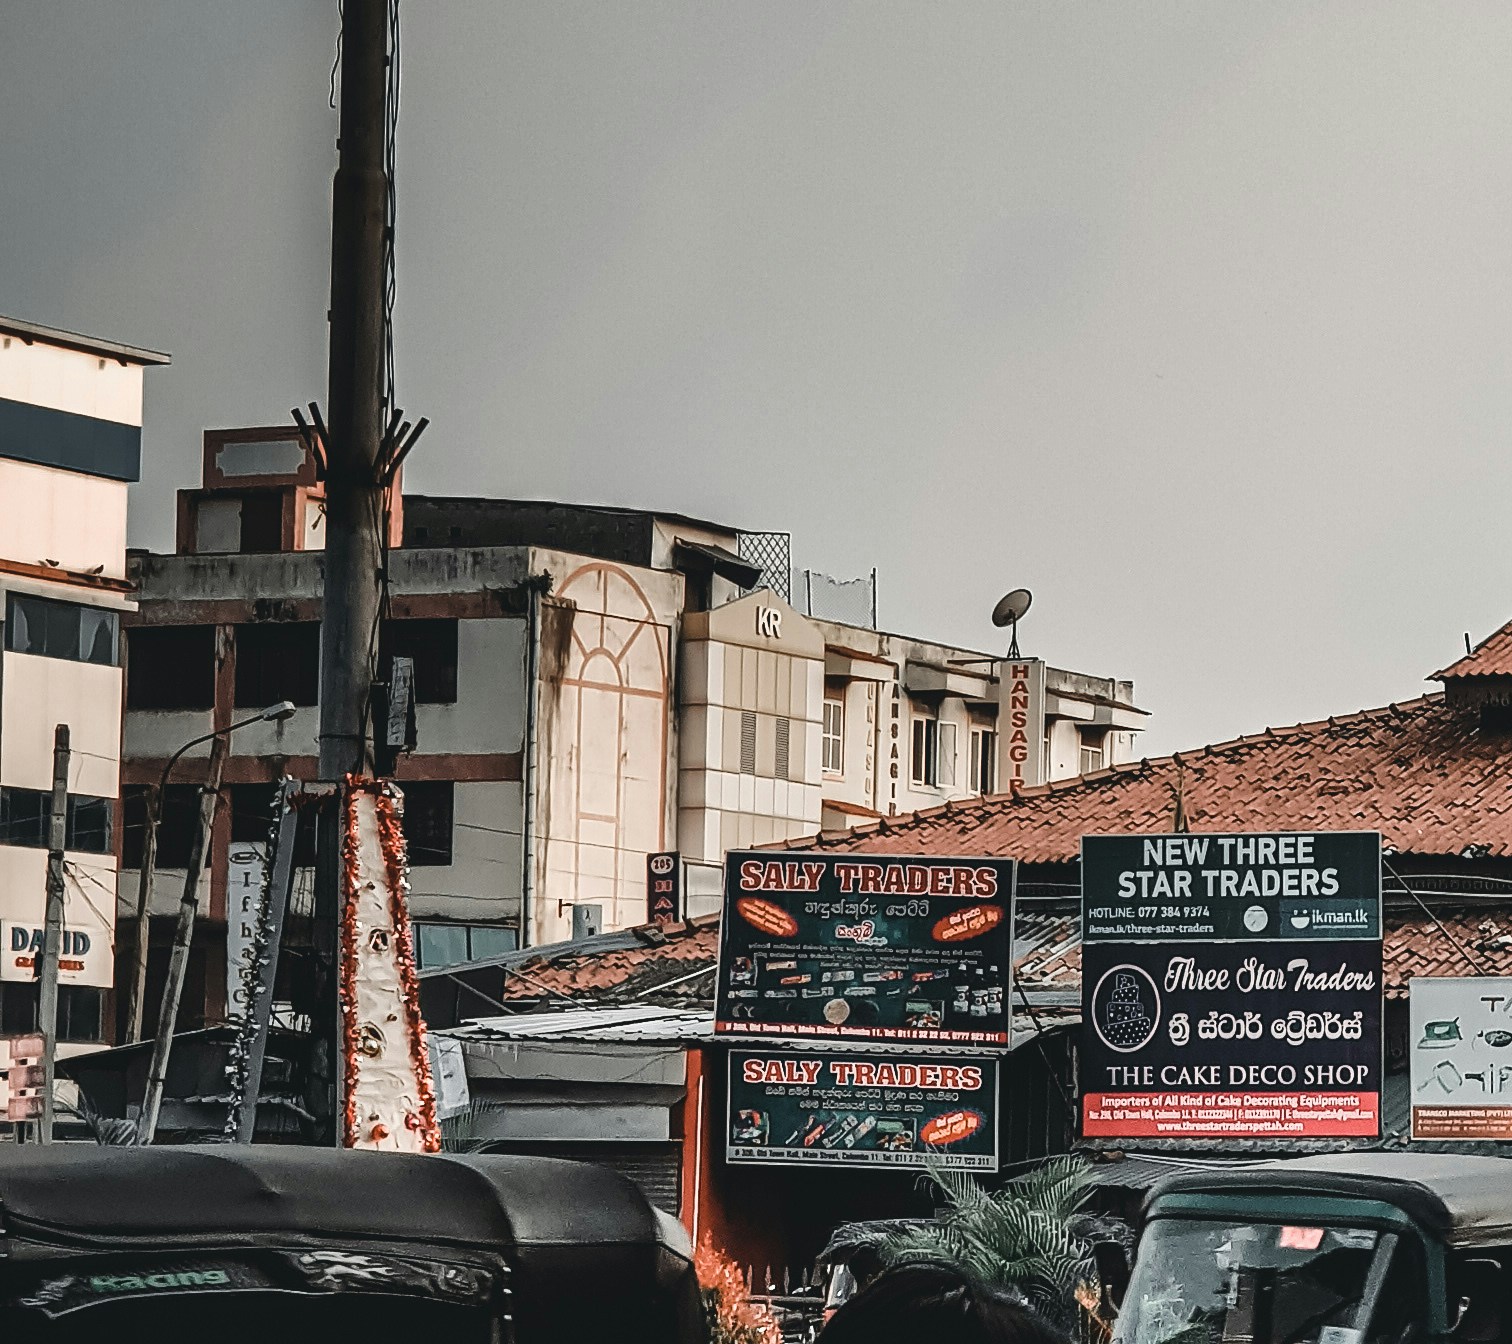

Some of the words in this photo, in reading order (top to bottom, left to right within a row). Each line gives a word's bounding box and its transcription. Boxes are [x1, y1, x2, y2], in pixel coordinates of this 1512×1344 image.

[756, 606, 781, 639] KR
[654, 859, 671, 869] 205
[1143, 838, 1209, 866] NEW
[1217, 836, 1315, 865] THREE
[740, 861, 825, 892] SALY
[834, 863, 998, 898] TRADERS
[1118, 869, 1192, 898] STAR
[1201, 868, 1340, 897] TRADERS
[1089, 907, 1135, 918] HOTLINE:
[1138, 907, 1158, 918] 077
[1161, 906, 1180, 917] 384
[1183, 906, 1210, 917] 9374
[1311, 908, 1368, 923] ikman.lk
[11, 927, 90, 956] DAID
[1164, 956, 1230, 993] Three
[1236, 956, 1287, 993] Star
[1287, 958, 1376, 992] Traders
[743, 1060, 821, 1084] SALY
[830, 1062, 982, 1091] TRADERS
[1106, 1066, 1154, 1086] THE
[1160, 1065, 1221, 1085] CAKE
[1229, 1065, 1297, 1085] DECO
[1303, 1064, 1369, 1085] SHOP
[1102, 1096, 1150, 1108] Importers
[1152, 1095, 1163, 1106] of
[1164, 1095, 1178, 1106] All
[1180, 1095, 1203, 1106] Kind
[1205, 1095, 1216, 1106] of
[1217, 1095, 1242, 1106] Cake
[1243, 1095, 1298, 1107] Decorating
[1299, 1095, 1360, 1107] Equipments
